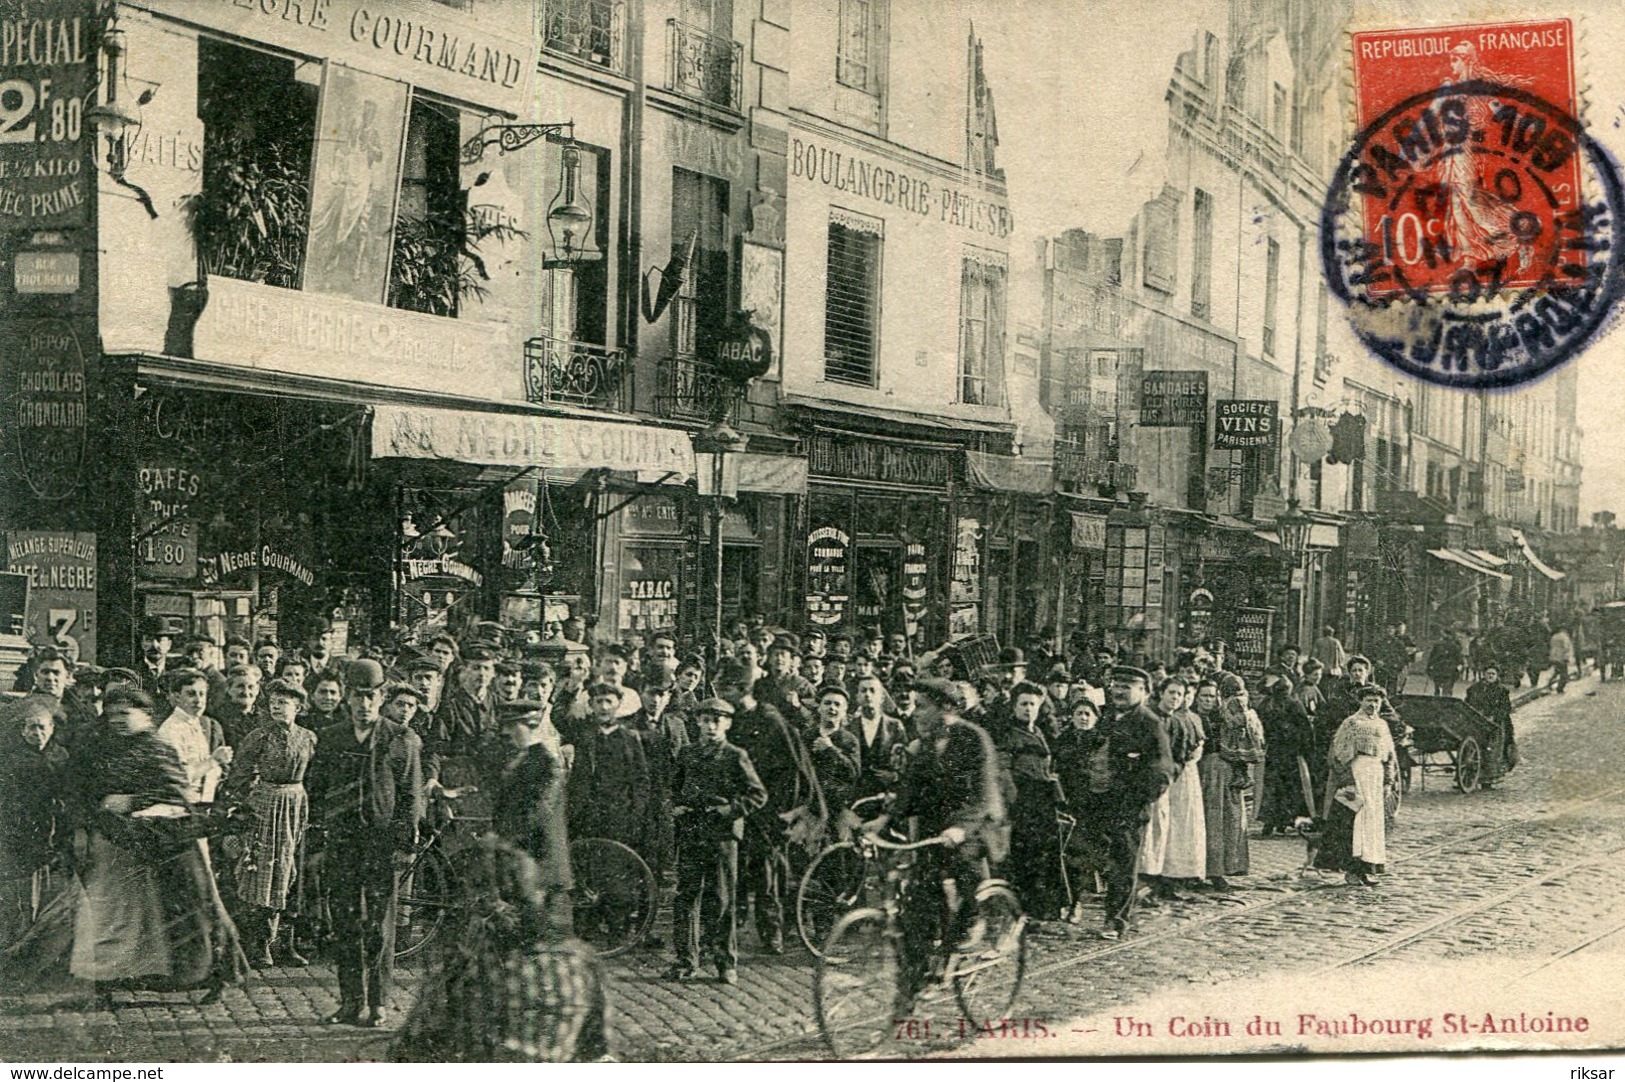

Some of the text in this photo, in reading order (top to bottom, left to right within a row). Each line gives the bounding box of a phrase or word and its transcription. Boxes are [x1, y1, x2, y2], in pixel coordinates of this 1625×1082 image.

[350, 7, 521, 89] GOURMAND
[1479, 28, 1565, 51] FRANÇAISE
[34, 159, 80, 178] KILO
[792, 138, 931, 217] BOULANGERIE
[30, 180, 84, 217] PRIME
[20, 371, 83, 392] CHOCOLATS
[1220, 417, 1271, 432] VINS
[1217, 433, 1275, 446] PARISIENNE
[262, 545, 314, 587] GOURMAND
[630, 580, 671, 599] TABAC
